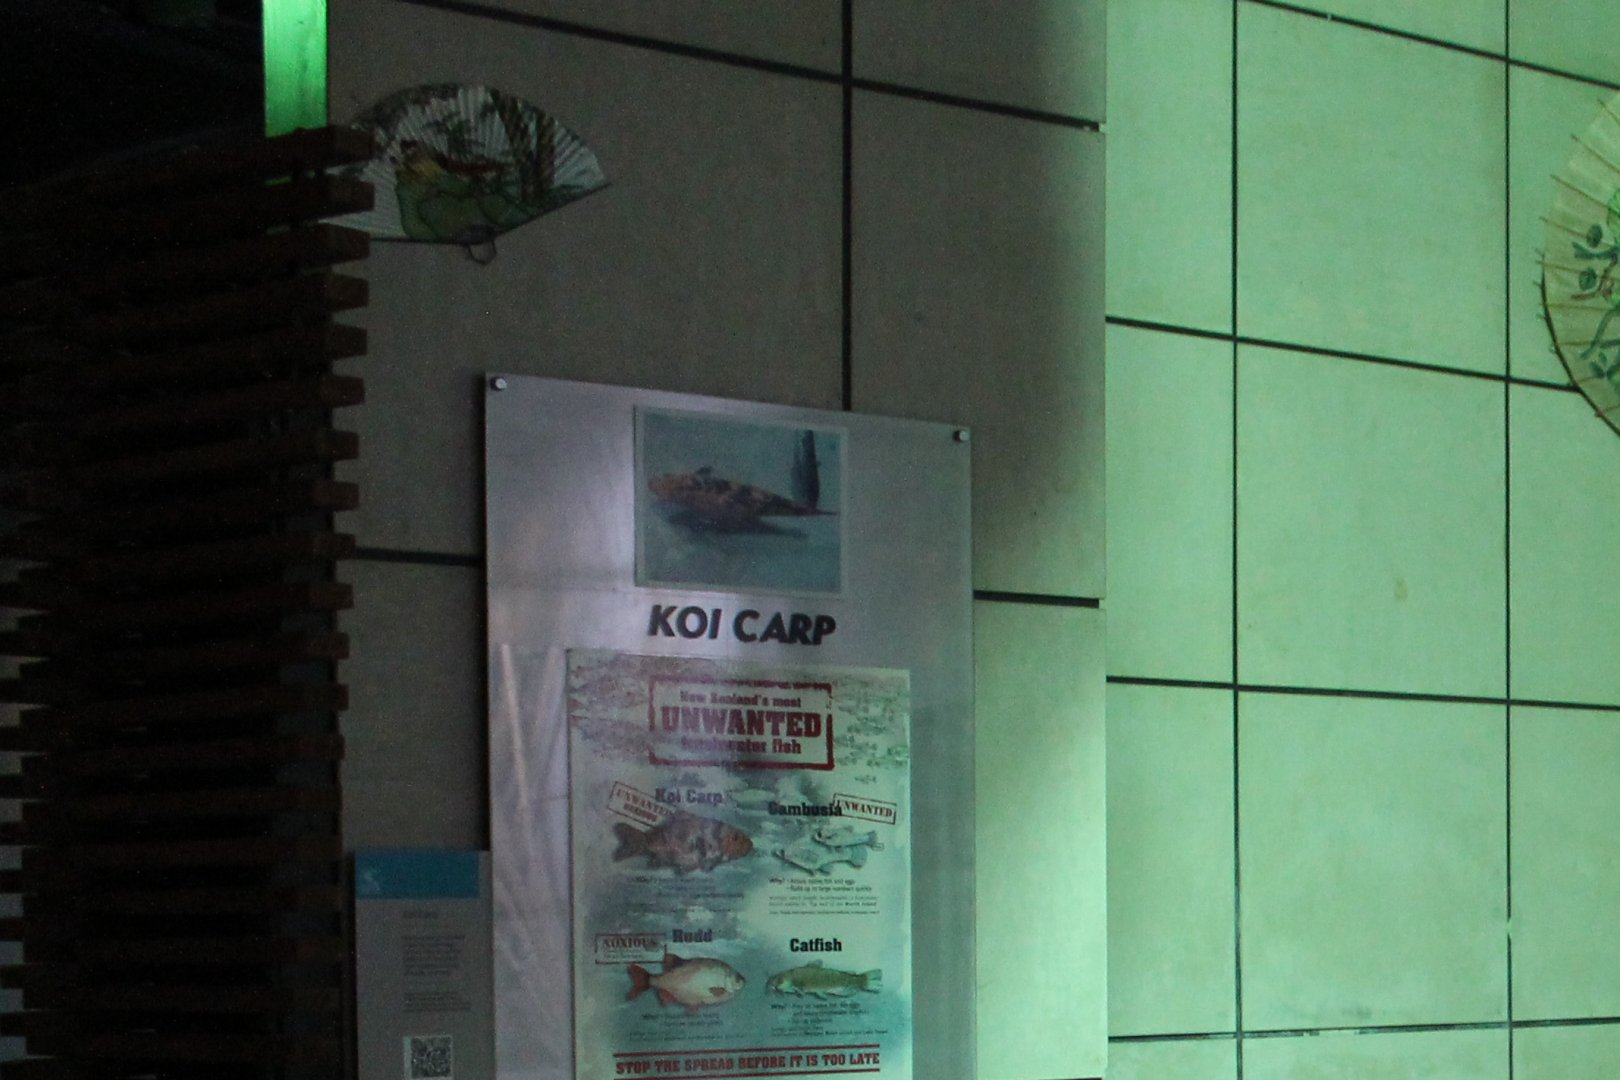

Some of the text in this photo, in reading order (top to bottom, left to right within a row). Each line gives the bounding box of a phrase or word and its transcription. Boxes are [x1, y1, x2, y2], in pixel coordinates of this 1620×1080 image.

[647, 604, 837, 645] KOI CARP
[661, 706, 822, 738] UNWANTED
[687, 788, 723, 807] Carp
[767, 800, 843, 817] Gambusia
[789, 937, 843, 953] Catfish
[615, 1060, 651, 1075] STOP
[738, 1055, 786, 1070] BEFORE
[789, 1054, 803, 1068] IT
[806, 1054, 818, 1067] IS
[821, 1053, 846, 1067] TOO
[849, 1052, 880, 1065] LATE
